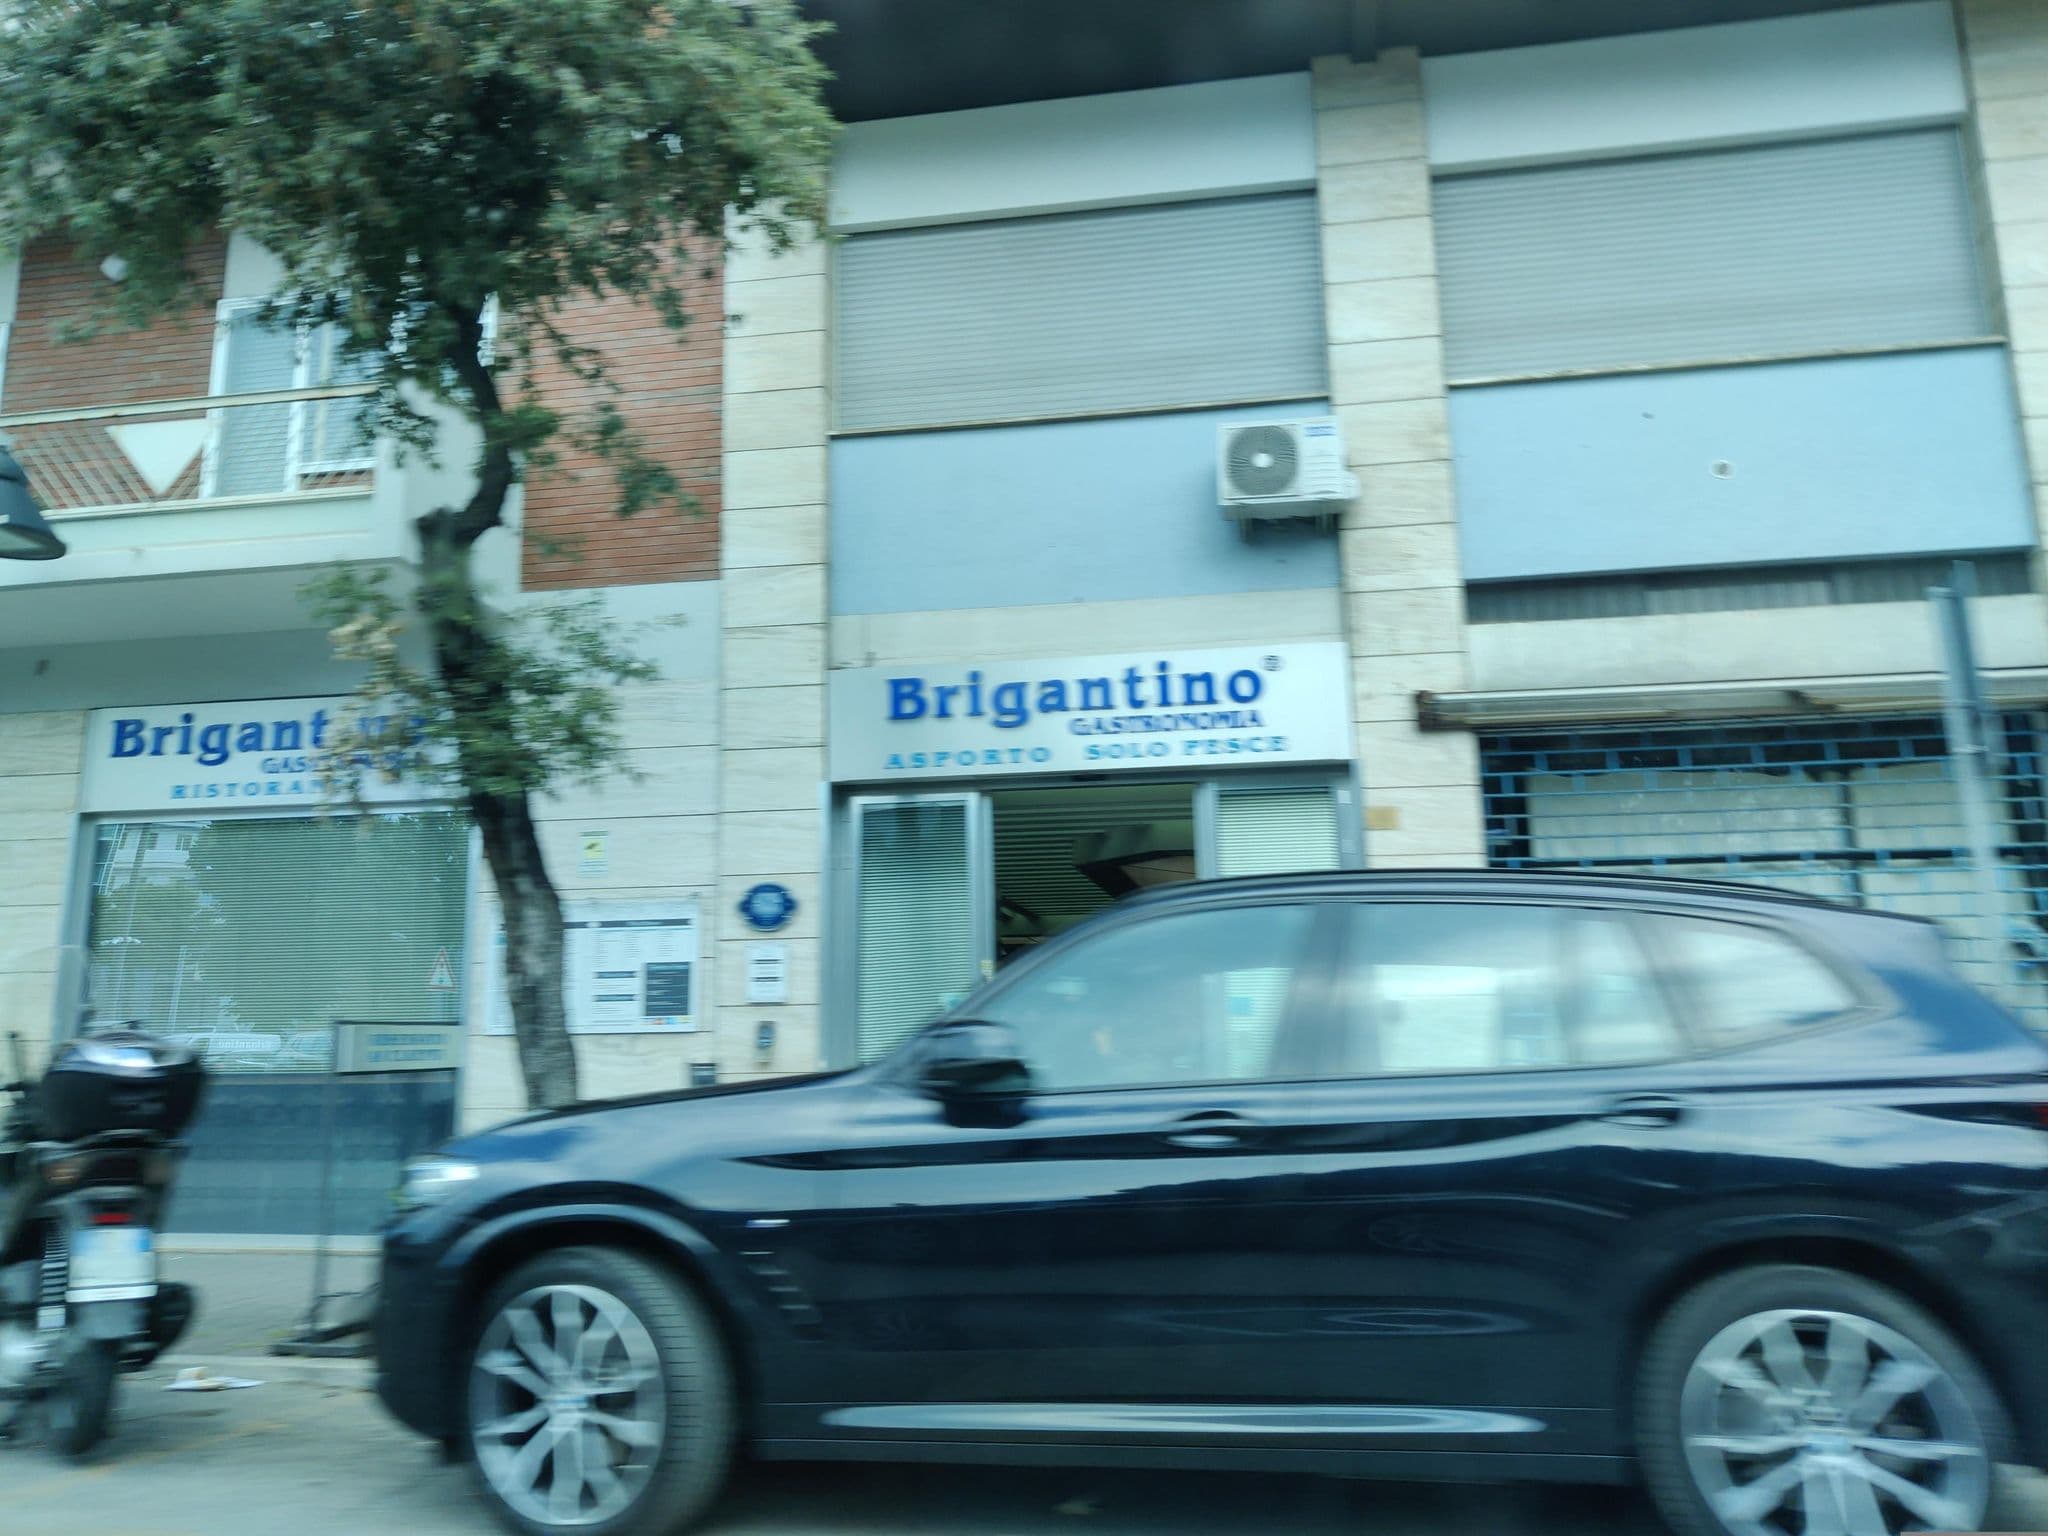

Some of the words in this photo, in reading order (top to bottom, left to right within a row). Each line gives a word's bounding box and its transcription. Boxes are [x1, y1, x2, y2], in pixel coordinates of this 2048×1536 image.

[886, 660, 1263, 729] Brigantino
[1069, 709, 1265, 736] GASTRONOMIA
[884, 747, 1052, 769] ASPORTO
[1084, 741, 1168, 760] SOLO
[1182, 735, 1288, 756] PESCE
